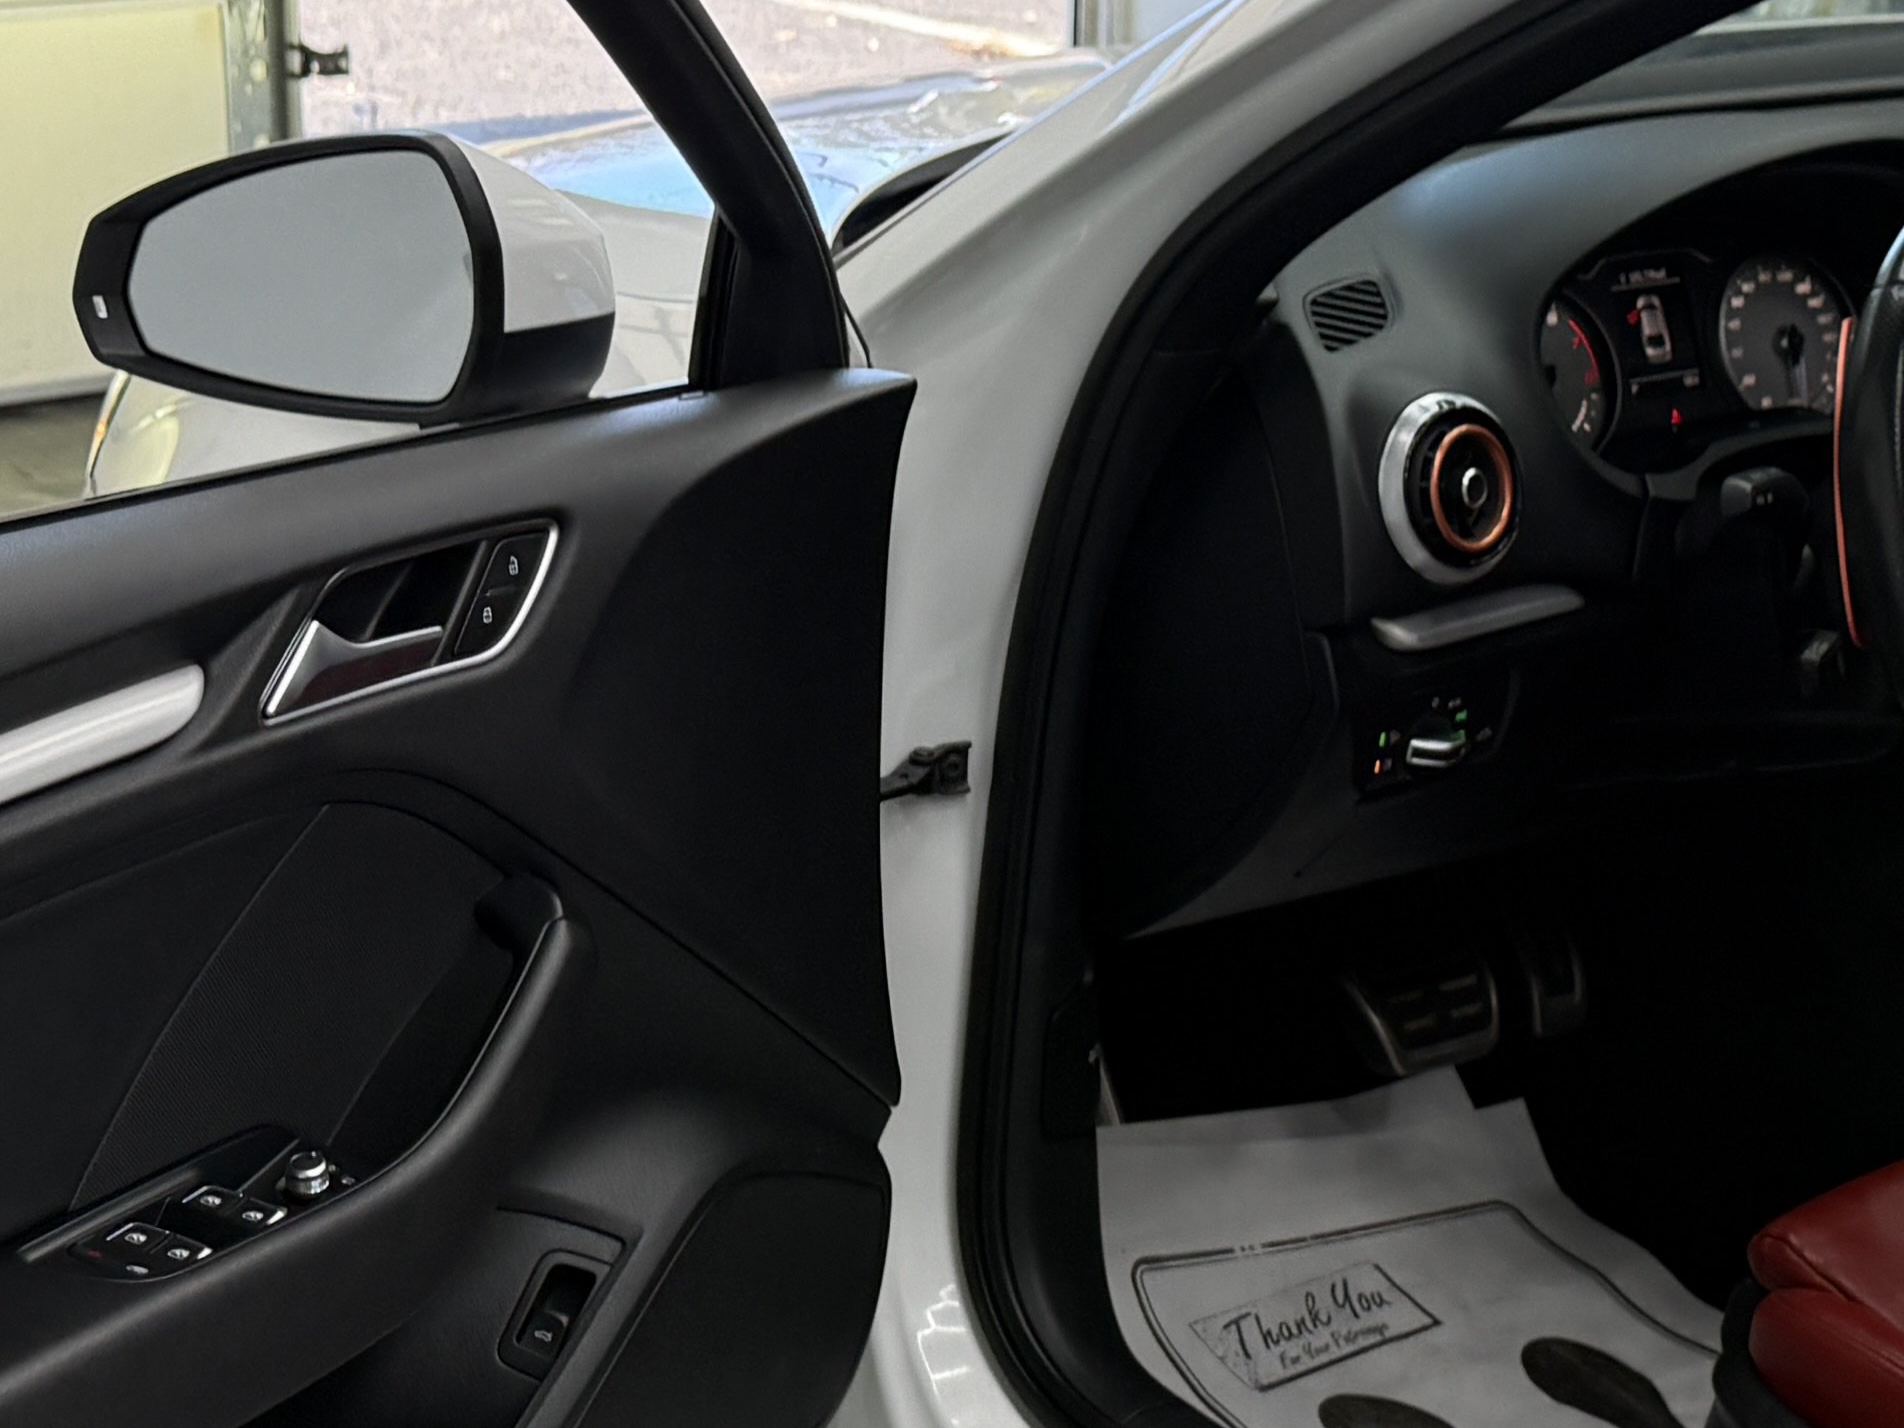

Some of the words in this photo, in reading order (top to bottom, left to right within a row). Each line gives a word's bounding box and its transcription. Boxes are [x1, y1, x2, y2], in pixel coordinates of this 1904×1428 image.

[1222, 1291, 1332, 1361] Thank
[1330, 1277, 1393, 1320] You
[1302, 1342, 1331, 1361] Your
